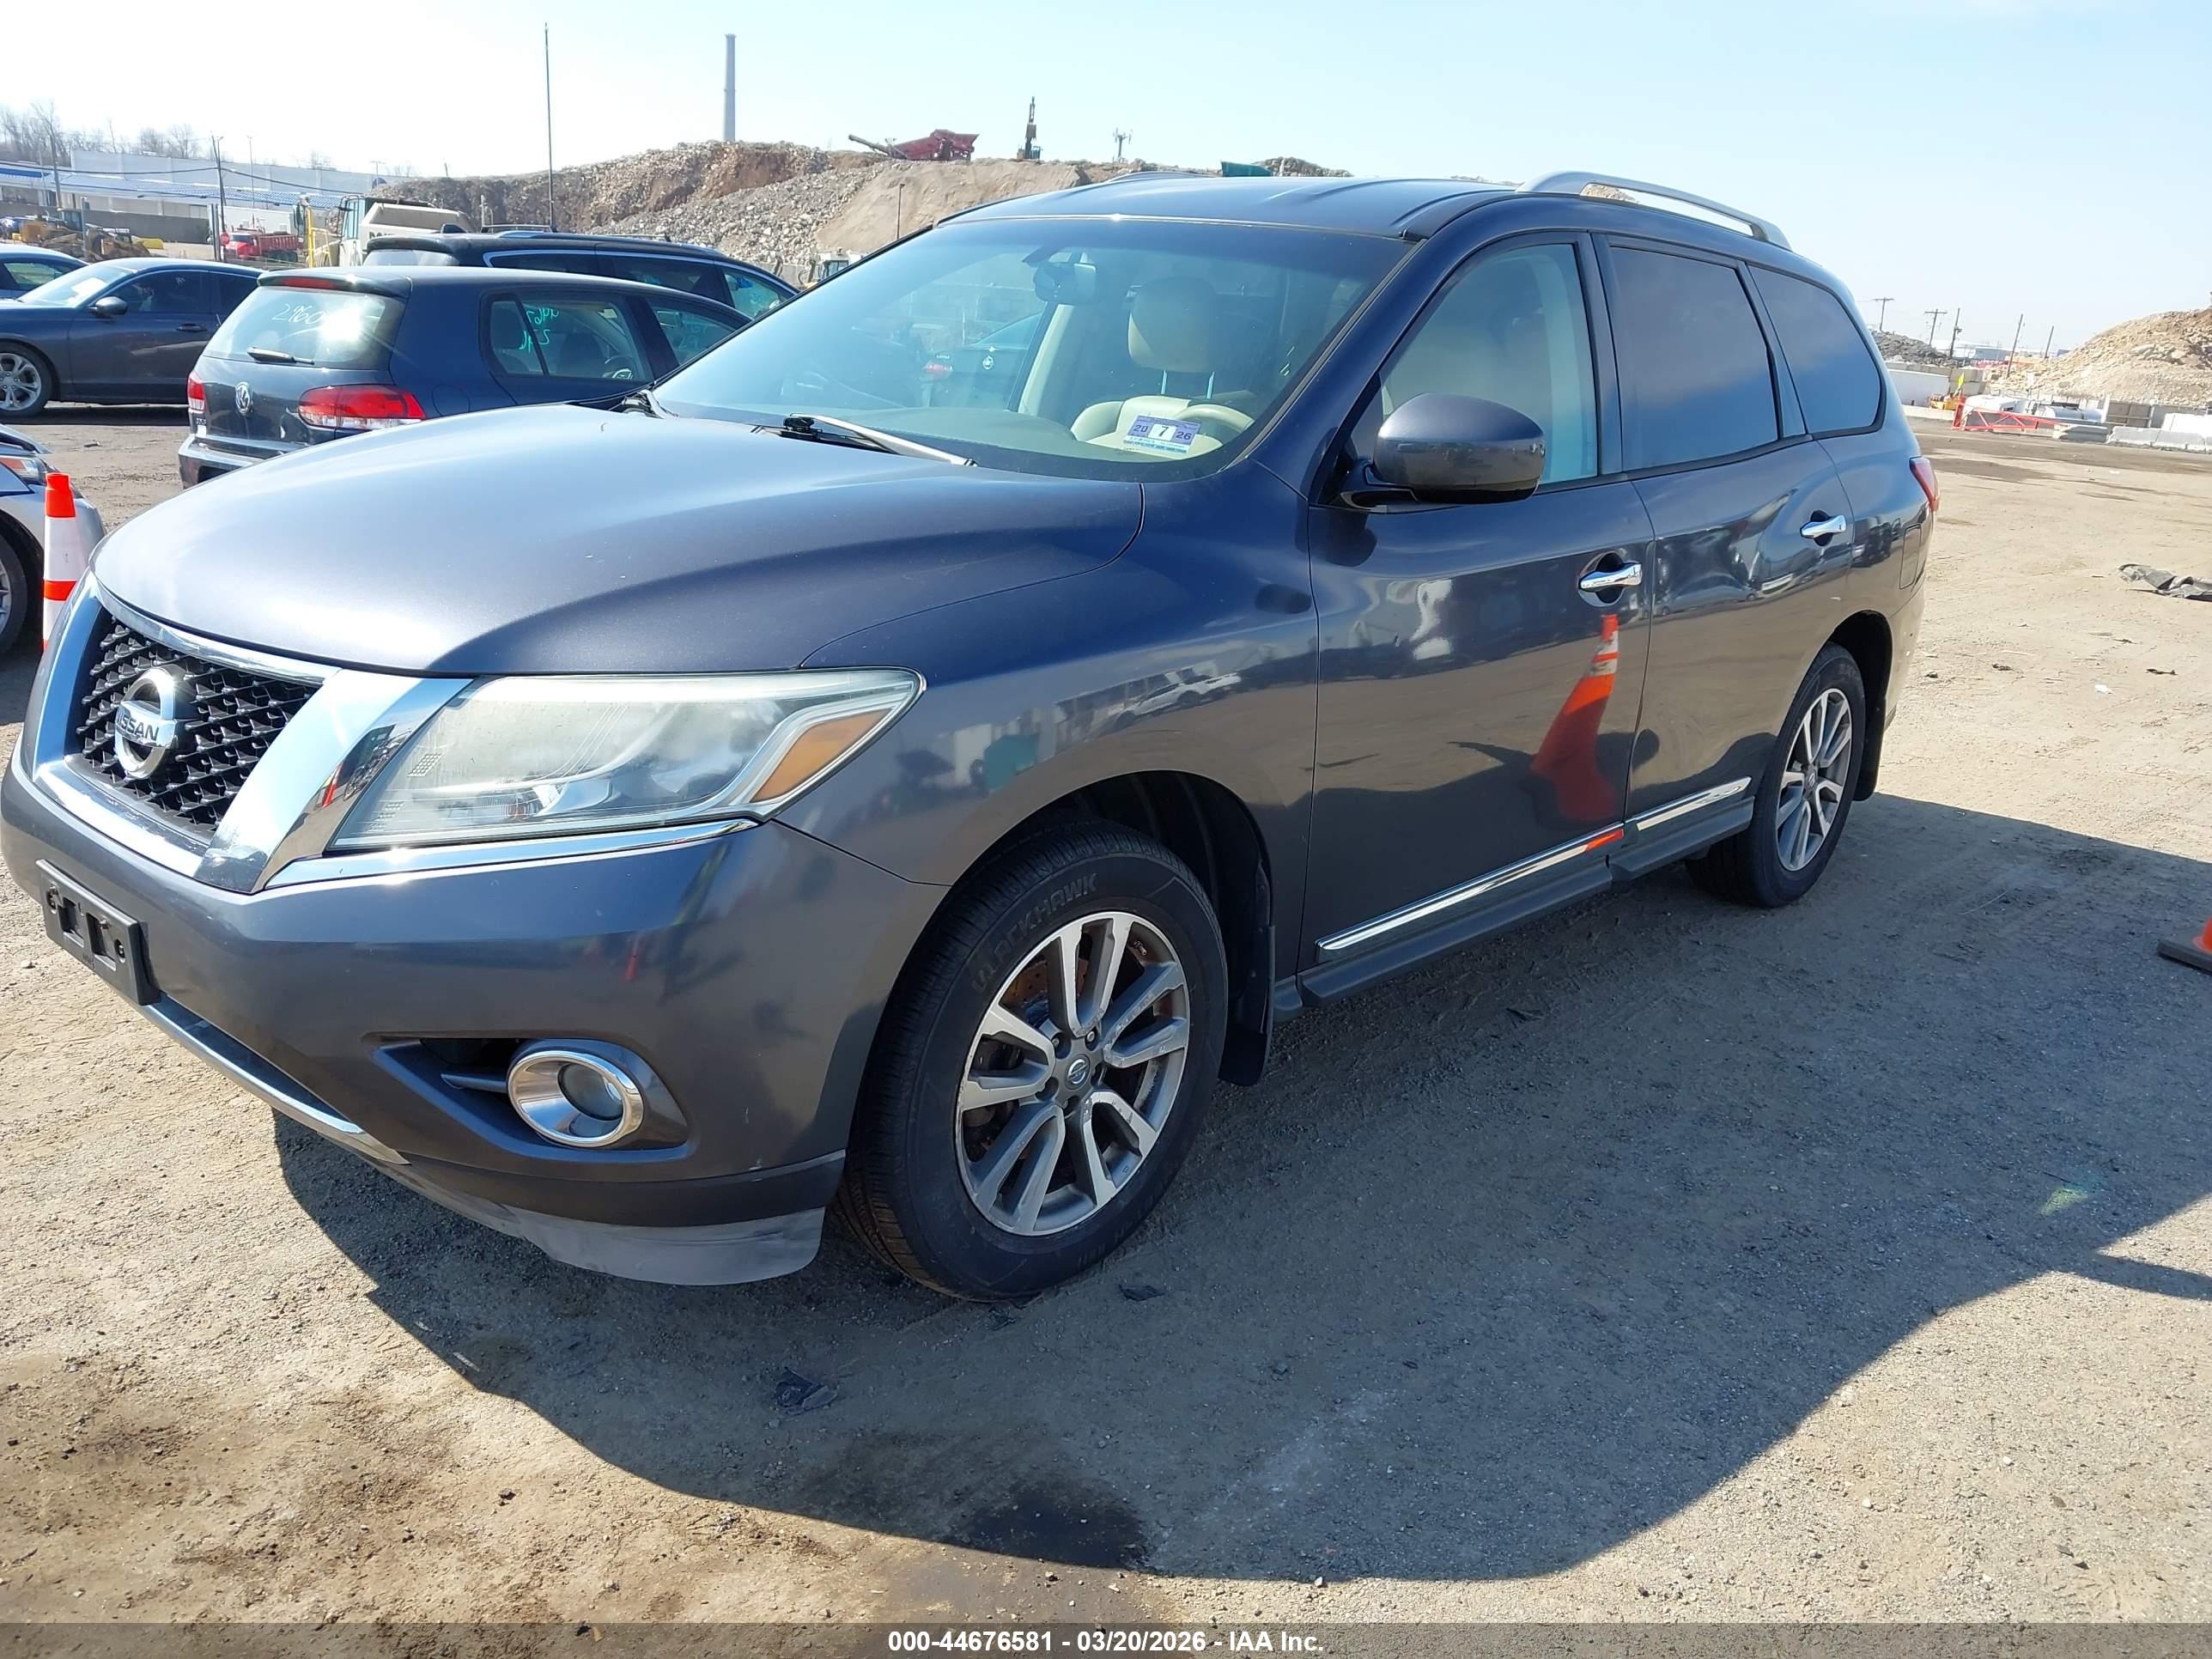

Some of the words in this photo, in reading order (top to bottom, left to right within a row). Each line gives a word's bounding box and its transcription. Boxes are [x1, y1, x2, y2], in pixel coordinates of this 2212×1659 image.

[1133, 424, 1149, 433] 20
[1158, 425, 1170, 437] 7
[1175, 431, 1193, 441] 26
